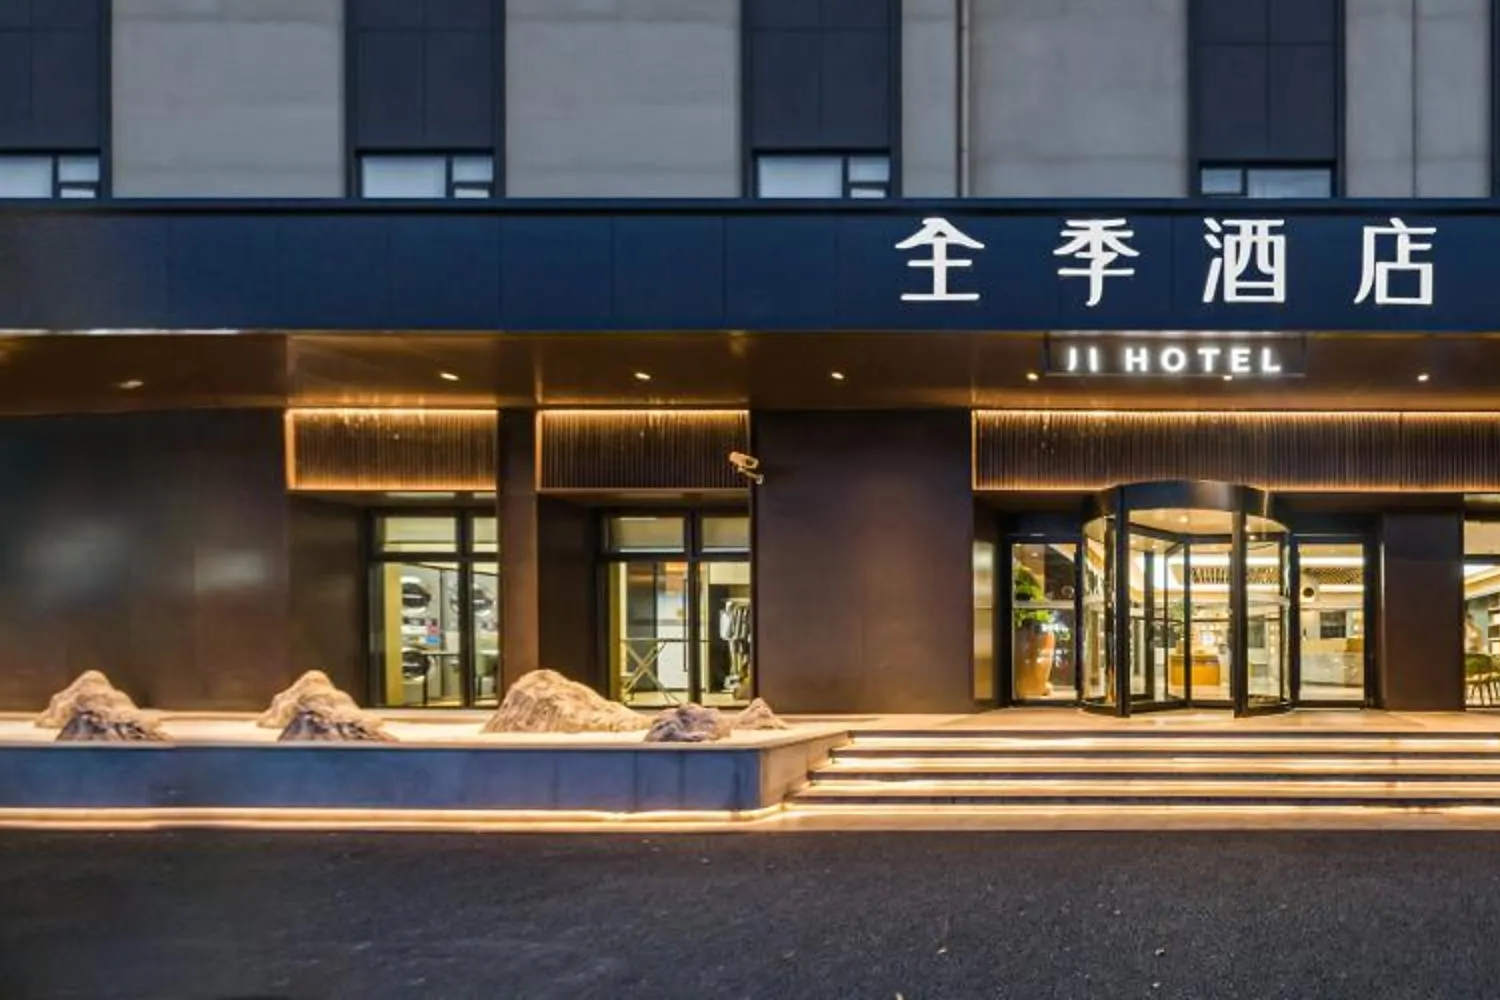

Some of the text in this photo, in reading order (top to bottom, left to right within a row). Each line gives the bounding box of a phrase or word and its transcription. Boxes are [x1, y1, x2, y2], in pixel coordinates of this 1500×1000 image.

[895, 217, 1437, 306] 全季酒店
[1067, 346, 1282, 373] JI HOTEL
